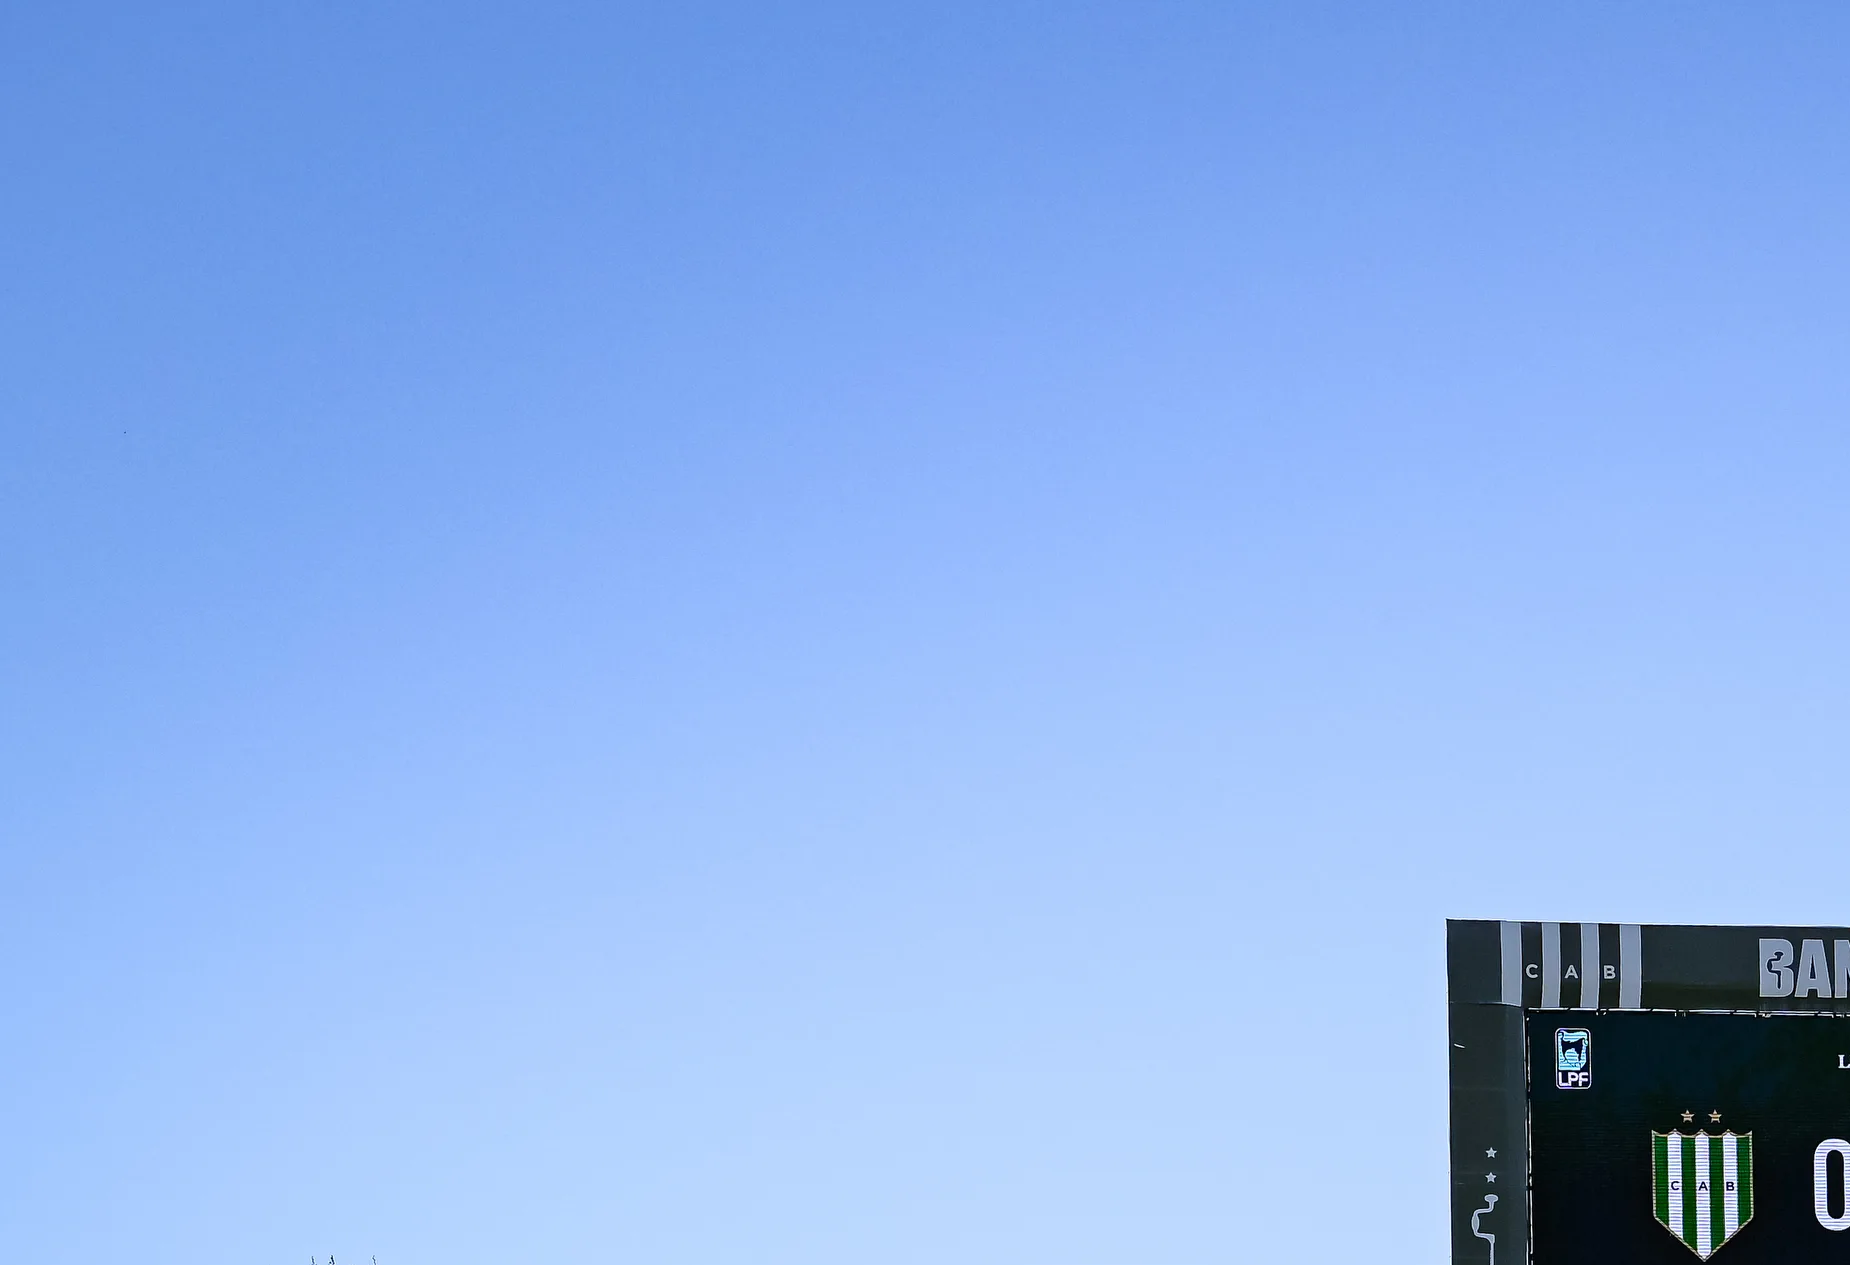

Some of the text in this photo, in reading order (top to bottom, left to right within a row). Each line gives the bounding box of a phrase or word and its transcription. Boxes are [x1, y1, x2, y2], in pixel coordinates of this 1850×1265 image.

[1525, 963, 1616, 980] C A B
[1558, 1072, 1588, 1087] LPF
[1670, 1180, 1735, 1191] C A B
